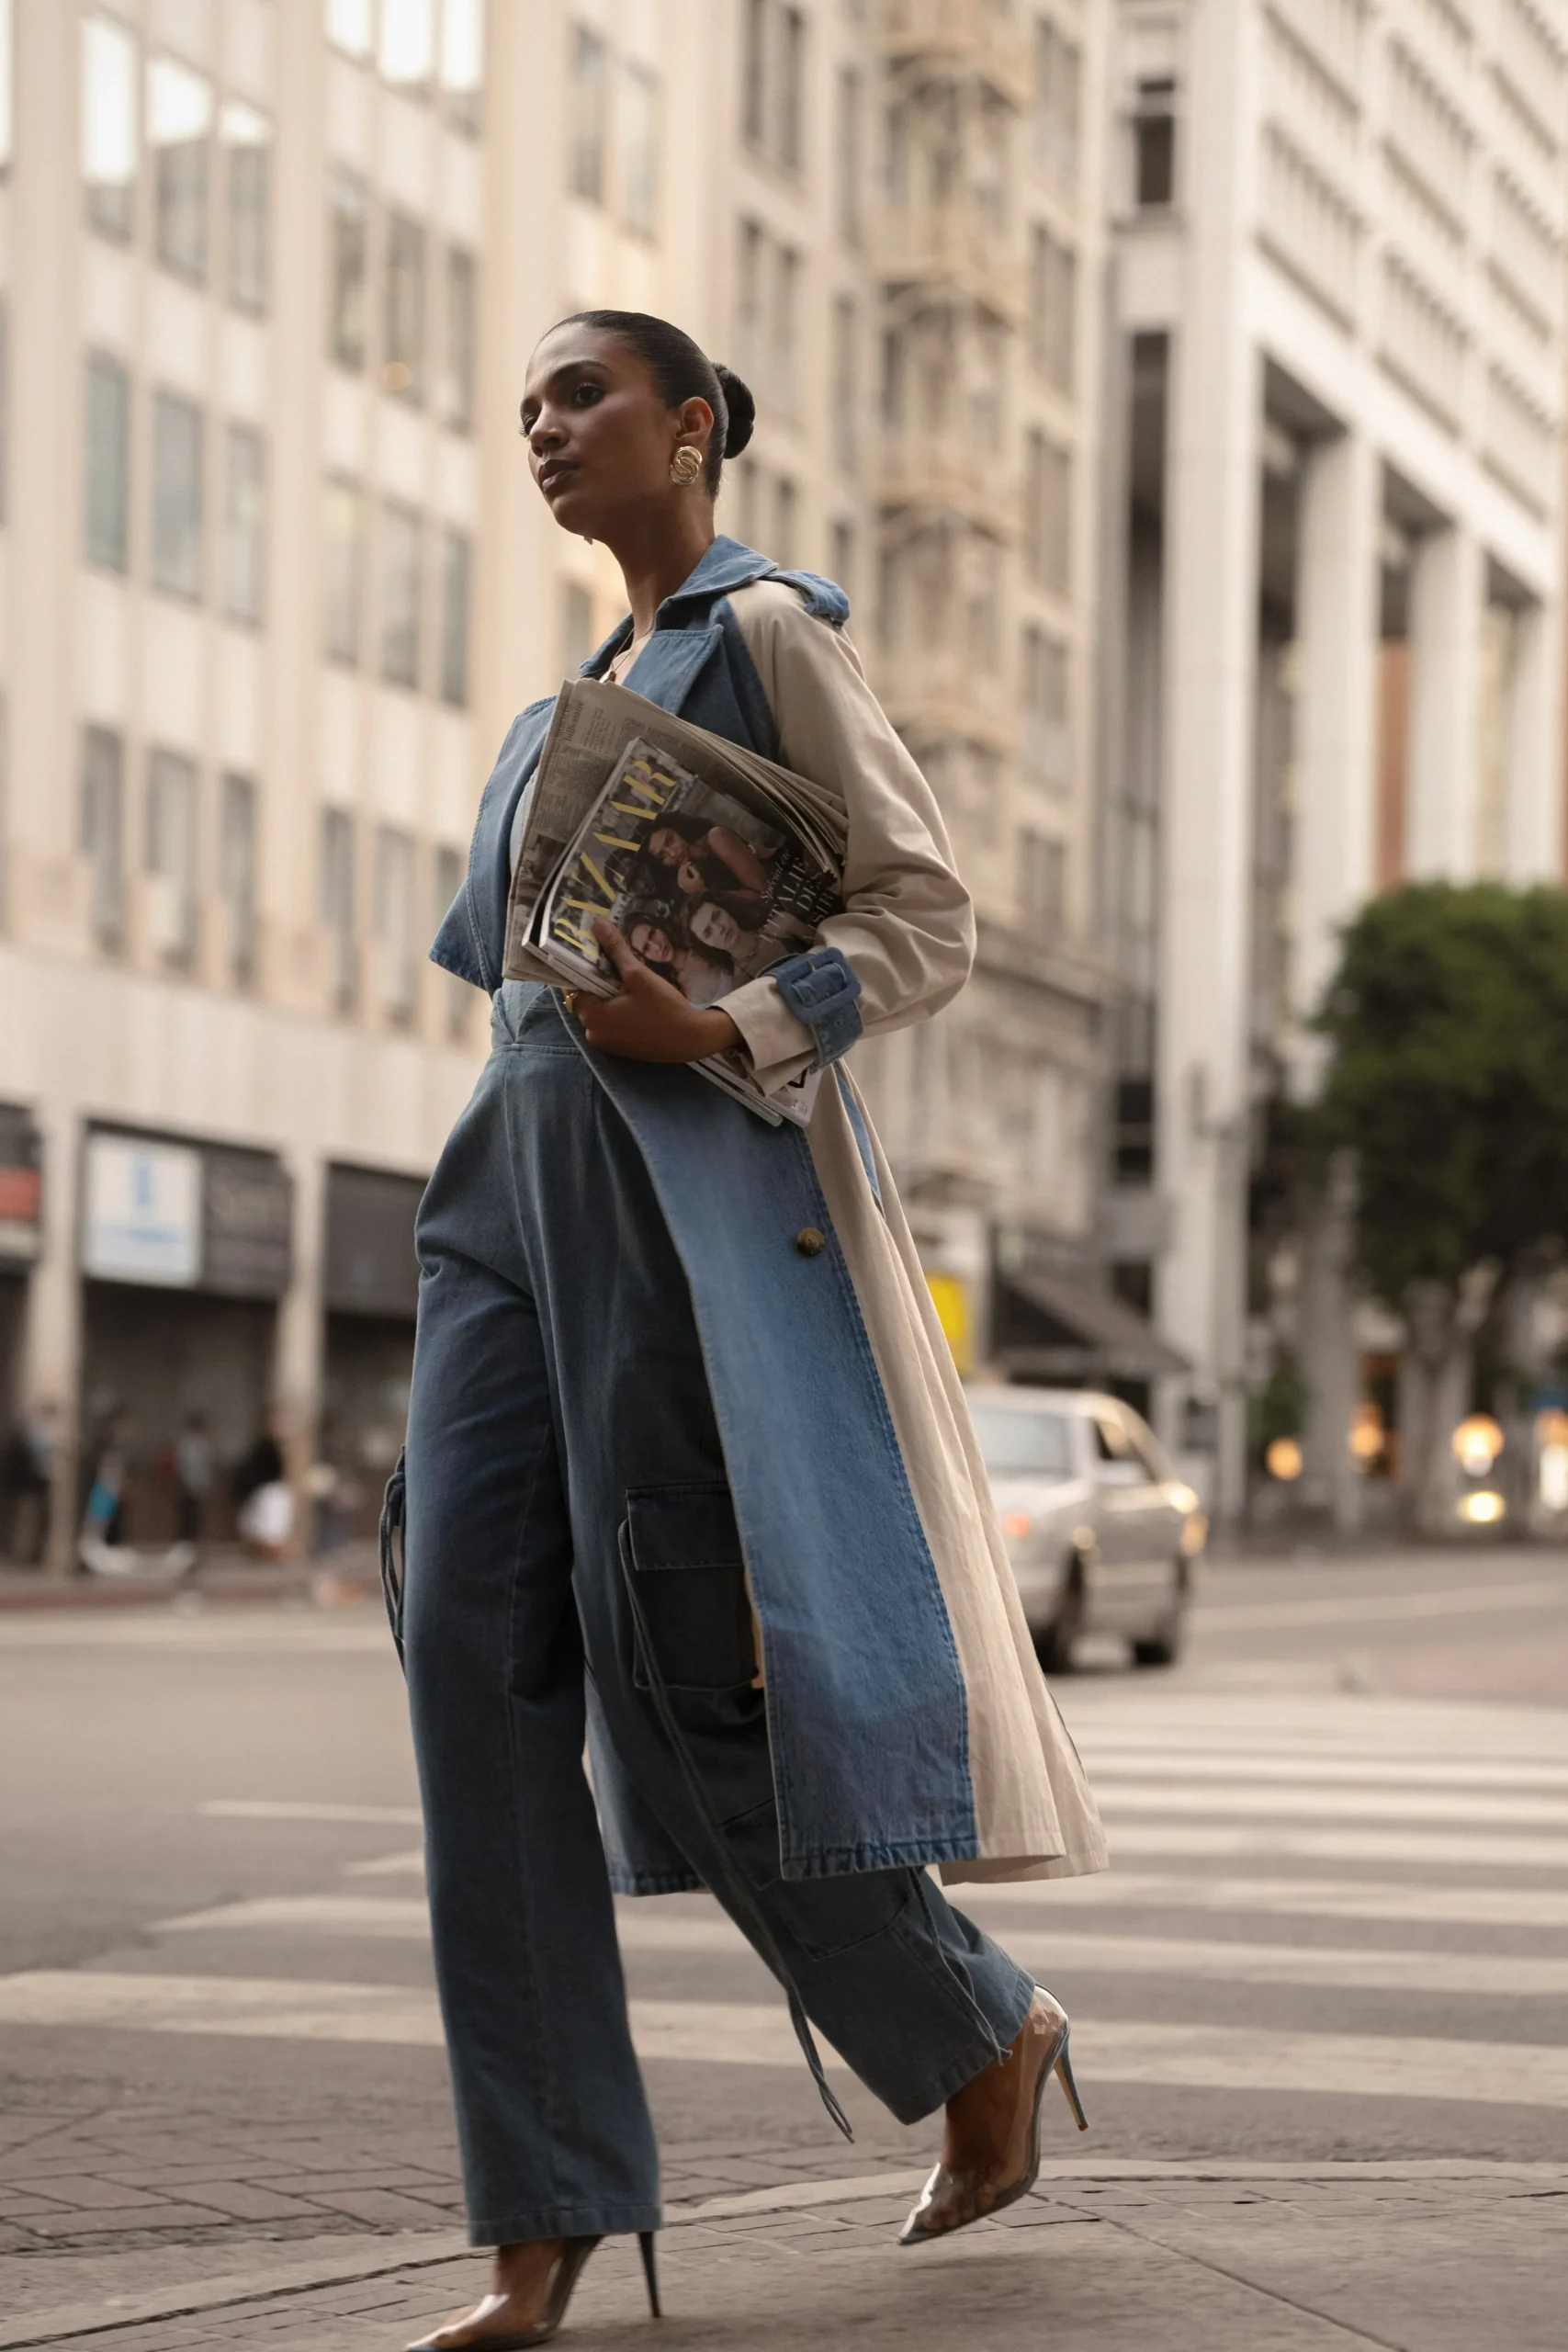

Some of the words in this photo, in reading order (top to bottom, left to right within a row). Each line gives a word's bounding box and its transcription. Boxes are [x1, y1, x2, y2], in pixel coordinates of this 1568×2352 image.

[554, 760, 678, 960] BAZAAR
[759, 857, 807, 944] L'ITALIE
[795, 868, 823, 911] DES
